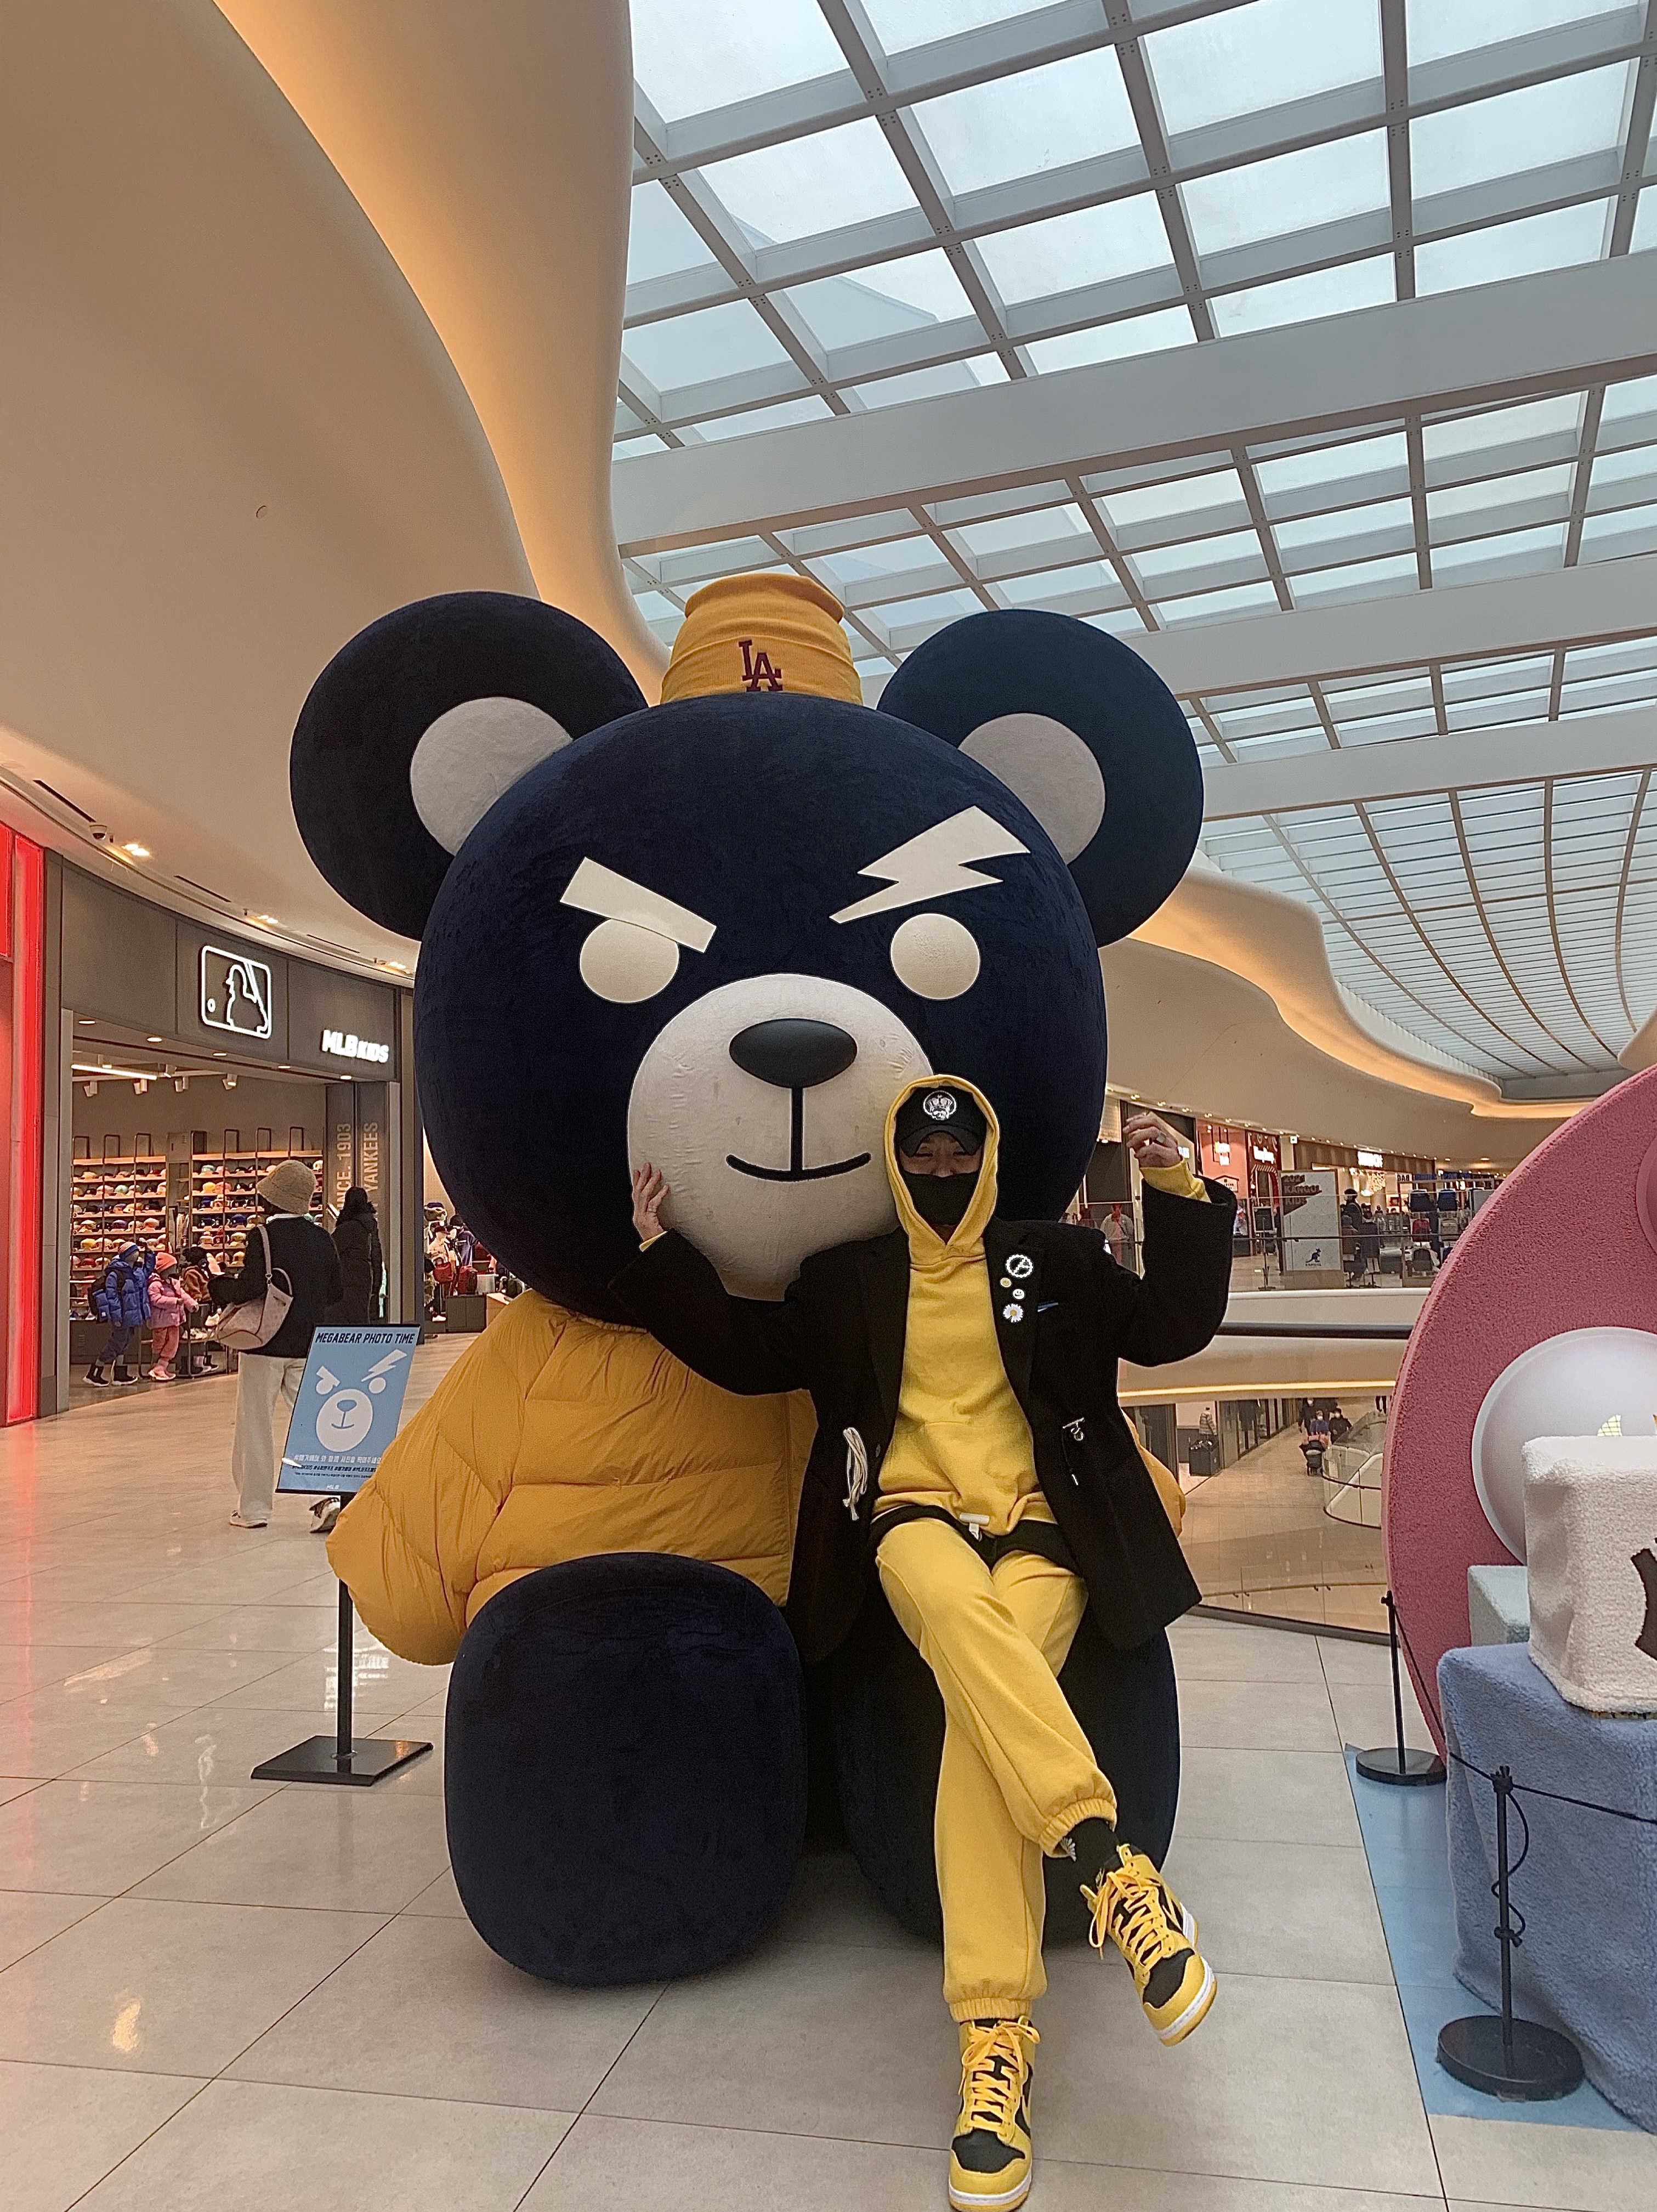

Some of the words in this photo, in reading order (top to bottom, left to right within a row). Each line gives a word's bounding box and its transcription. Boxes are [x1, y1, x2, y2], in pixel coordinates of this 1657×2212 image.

[739, 640, 783, 692] LA
[337, 1123, 351, 1161] 1903
[364, 1122, 378, 1192] YANKEES
[315, 1333, 362, 1343] MEGABEAR
[362, 1333, 393, 1344] PHOTO
[395, 1333, 415, 1344] TIME
